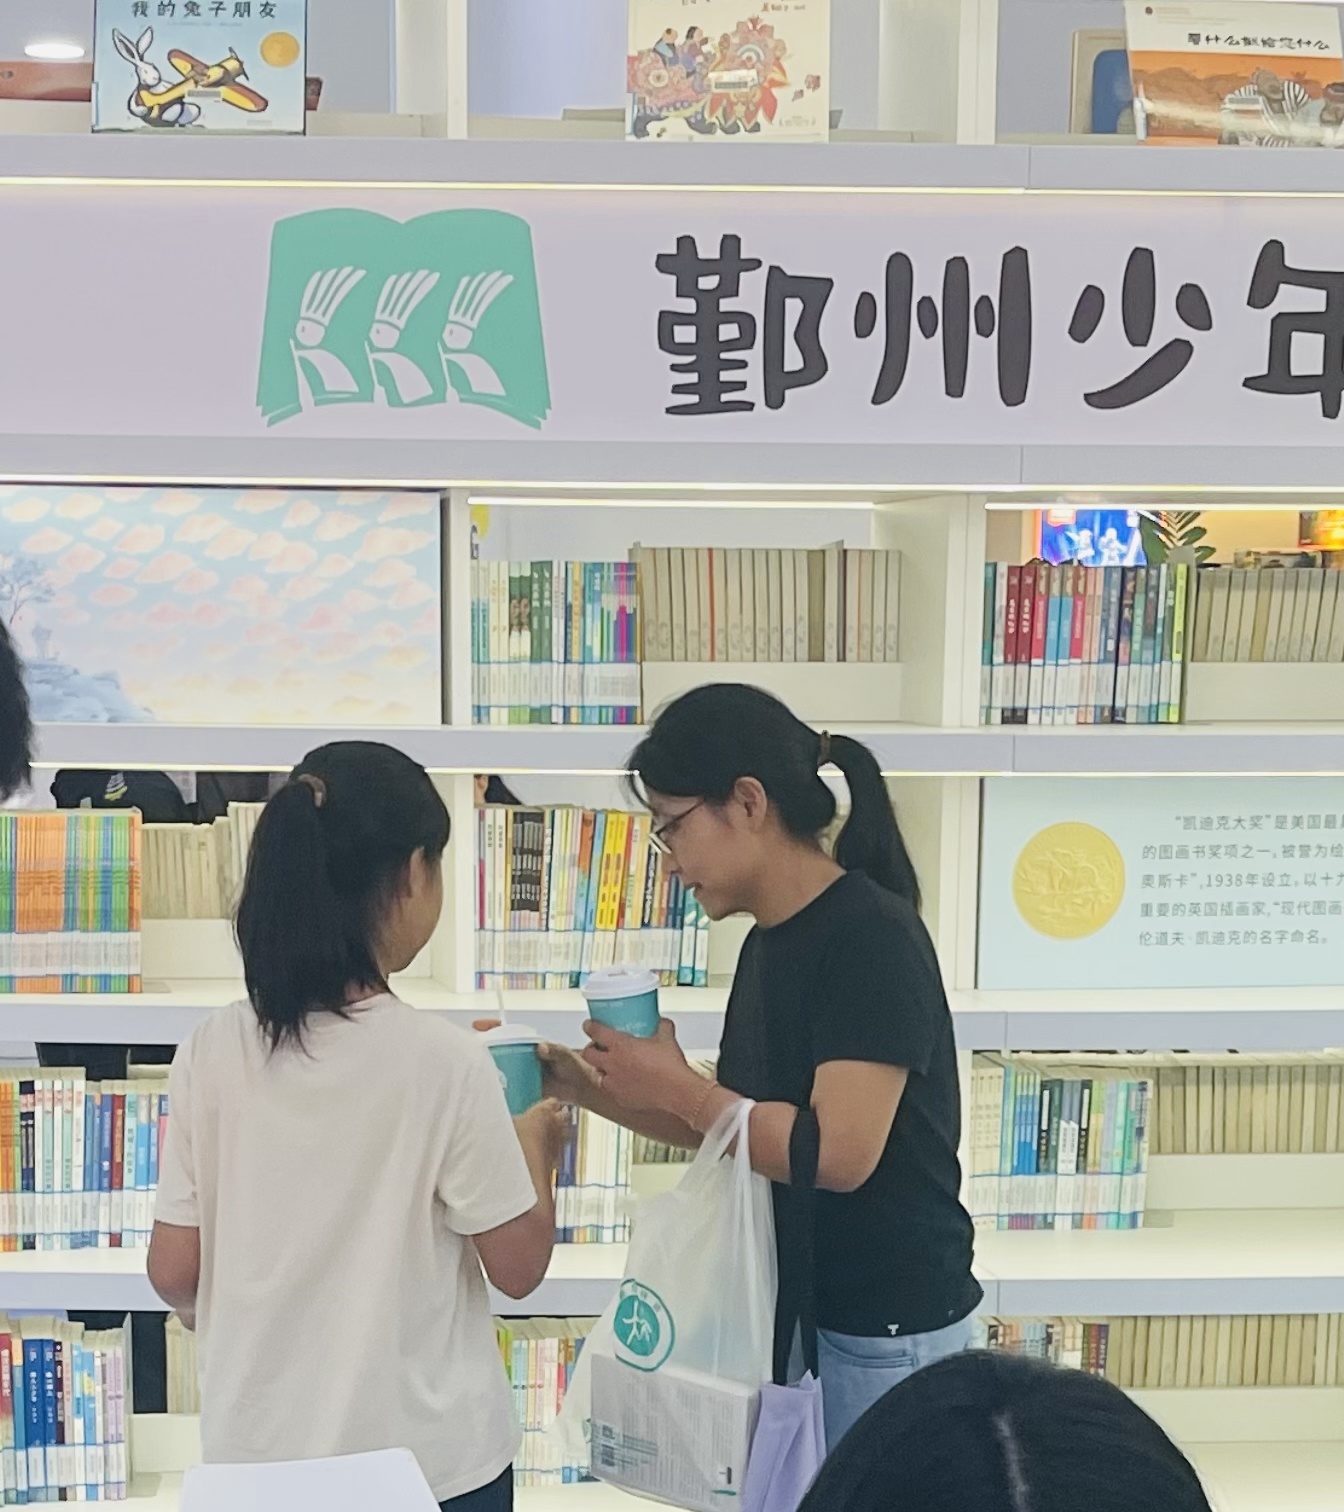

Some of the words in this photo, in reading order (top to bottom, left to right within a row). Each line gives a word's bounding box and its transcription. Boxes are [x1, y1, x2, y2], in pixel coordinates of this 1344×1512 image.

[131, 0, 277, 18] 我的兔子朋友
